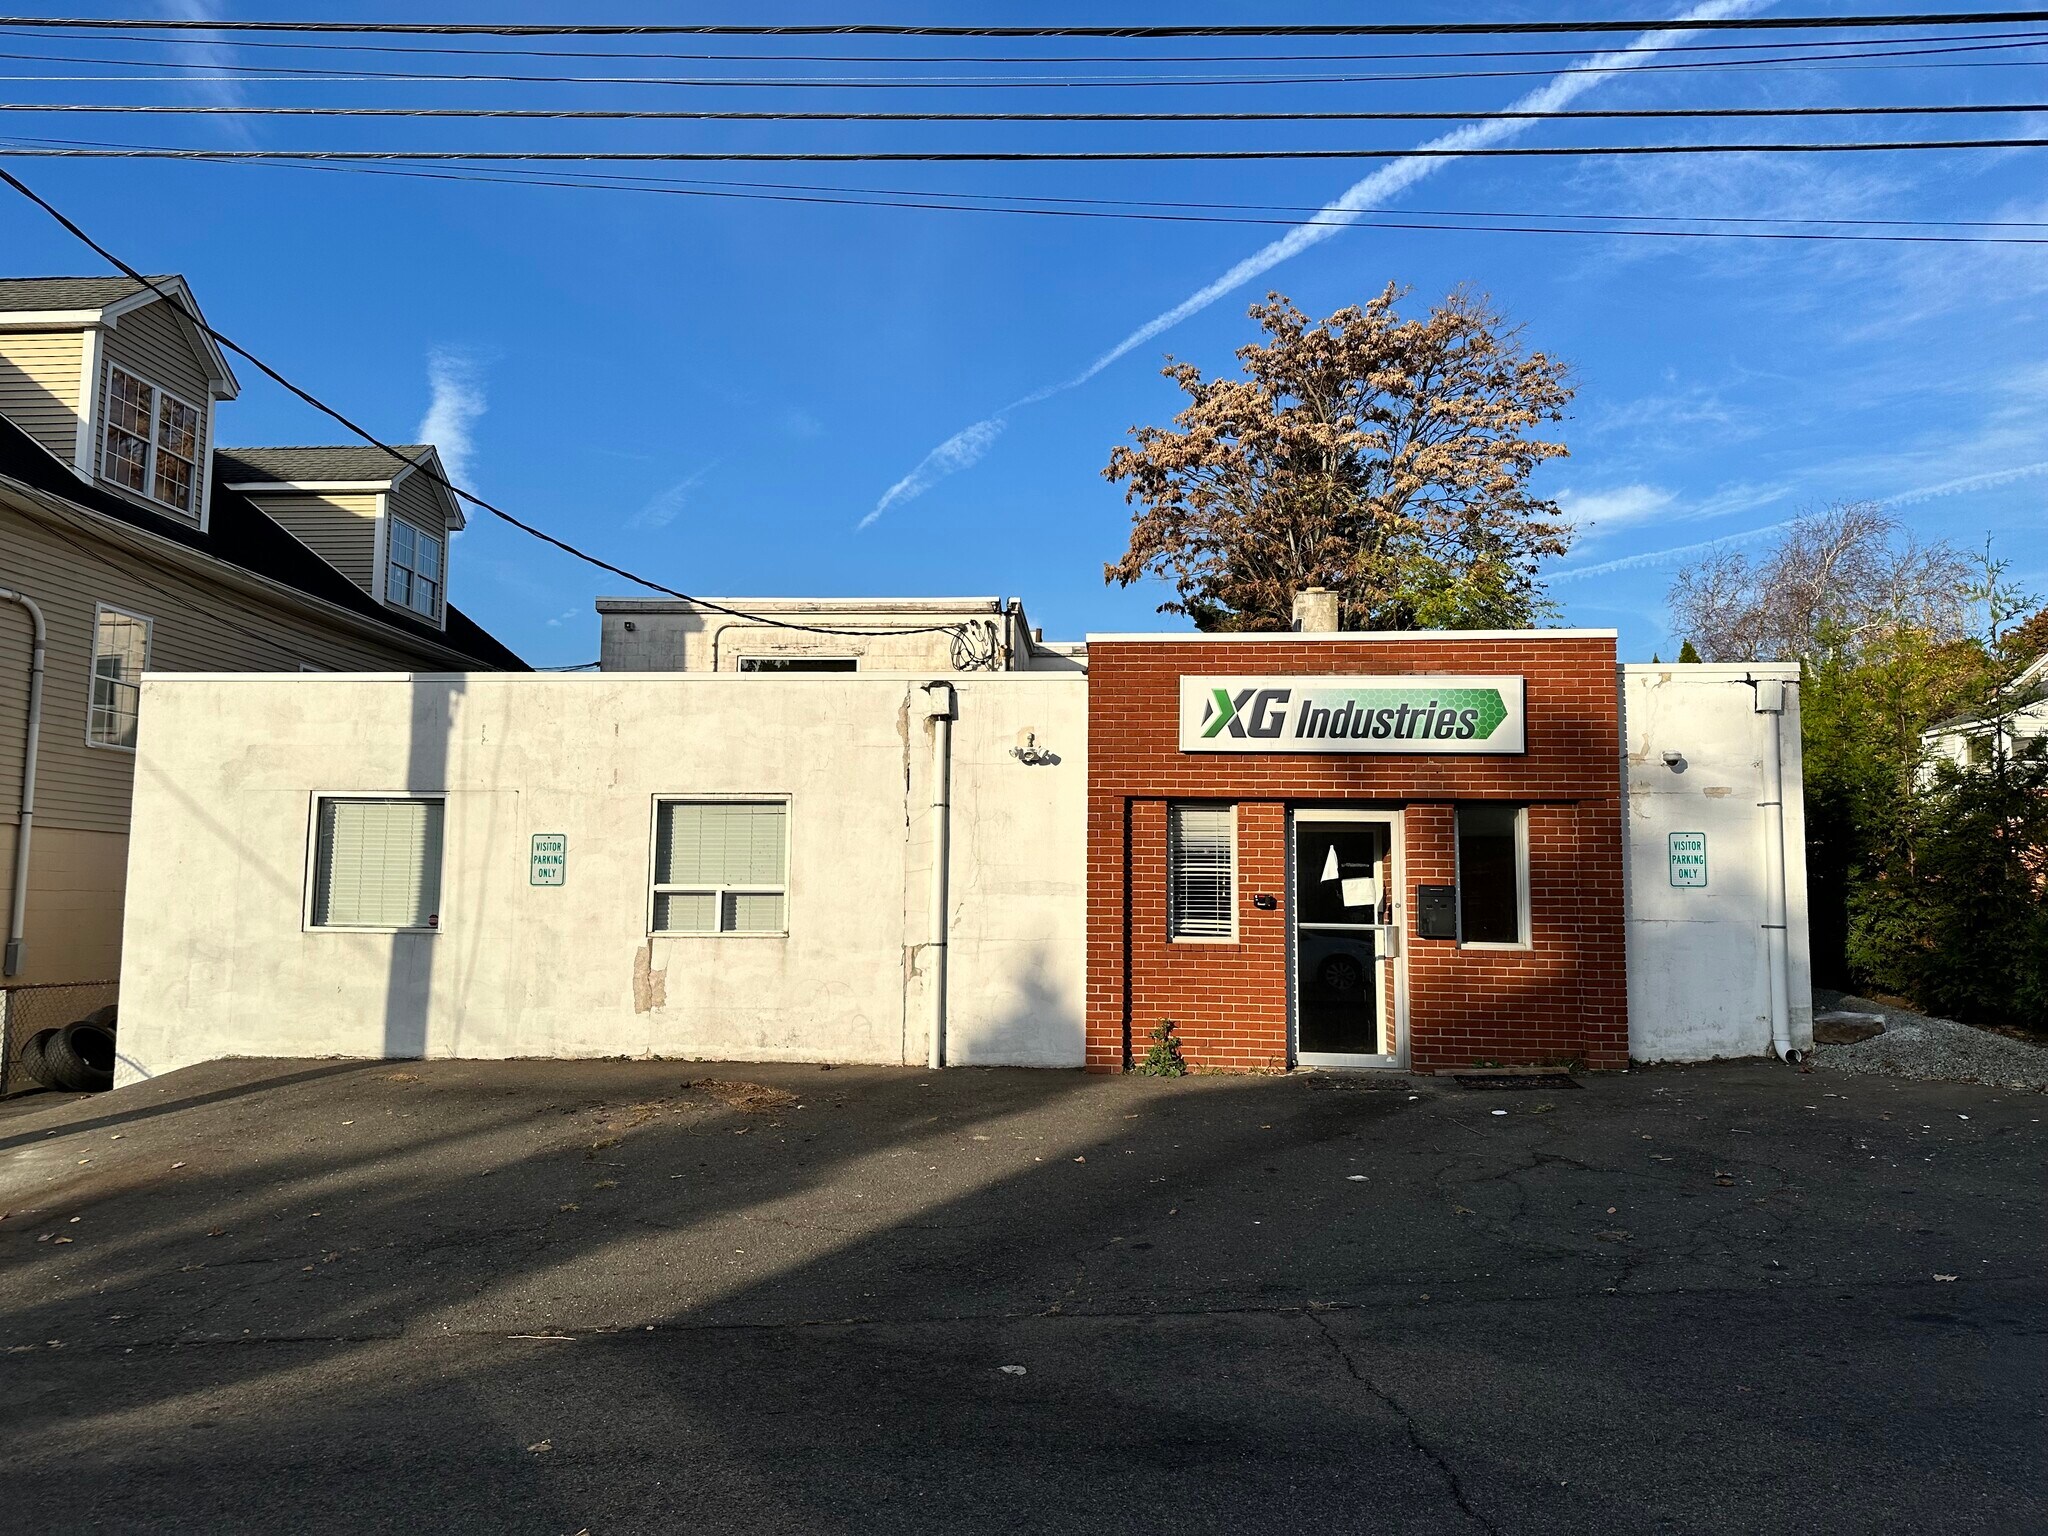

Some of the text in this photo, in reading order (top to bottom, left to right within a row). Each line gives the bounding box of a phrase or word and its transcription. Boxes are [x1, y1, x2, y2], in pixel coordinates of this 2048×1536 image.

[1201, 688, 1478, 739] XG Industries
[536, 842, 562, 851] VISITOR
[1673, 841, 1702, 850] VISITOR
[533, 855, 563, 864] PARKING
[1672, 855, 1704, 864] PARKING
[538, 868, 557, 877] ONLY
[1678, 868, 1698, 878] ONLY
